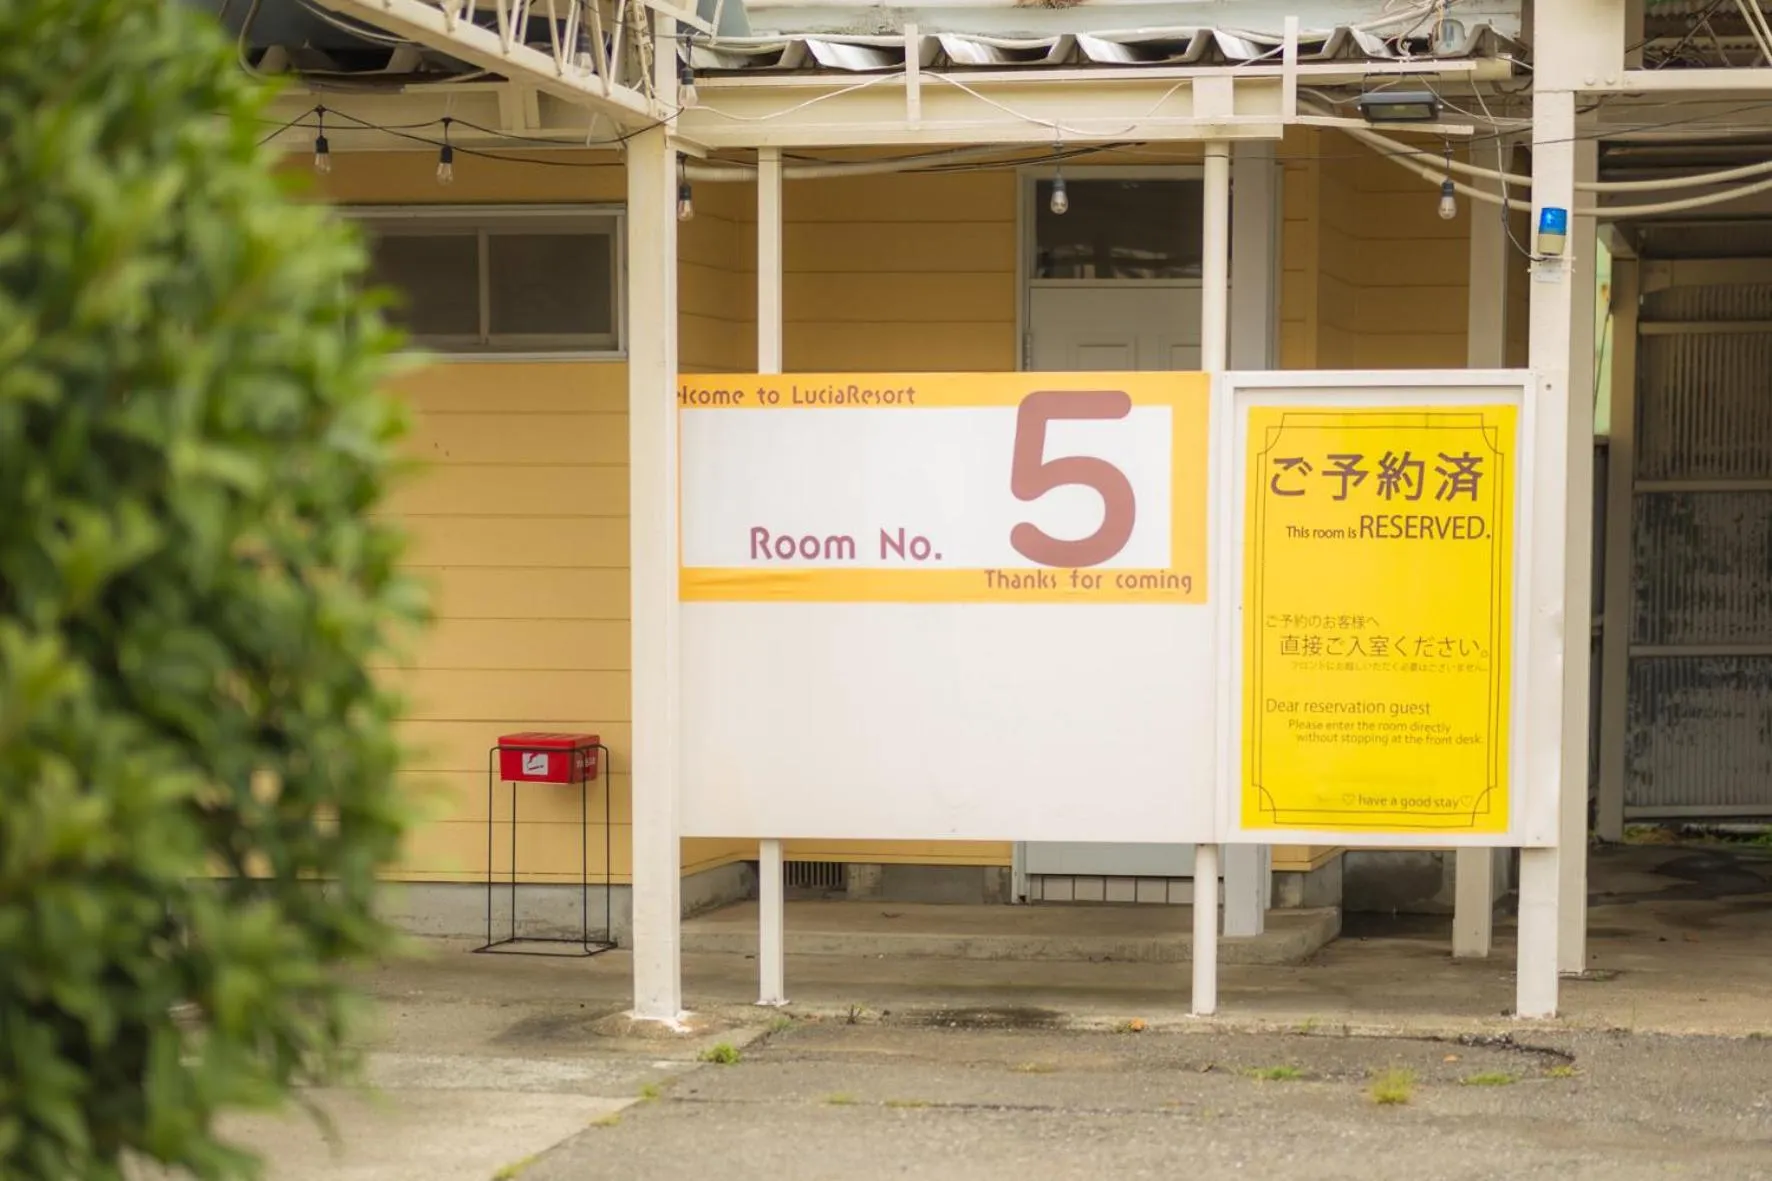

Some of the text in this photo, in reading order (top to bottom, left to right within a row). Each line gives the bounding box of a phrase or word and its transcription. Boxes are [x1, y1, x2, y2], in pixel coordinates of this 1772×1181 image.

[756, 387, 780, 405] to
[792, 385, 915, 405] LuciaResort
[750, 390, 1136, 568] Room No. 5
[1270, 450, 1484, 502] ご予約済
[1286, 514, 1492, 540] This room is RESERVED.
[984, 568, 1193, 595] Thanks for coming
[1265, 614, 1380, 630] ご予約のお客様へ
[1280, 634, 1489, 659] 直接ご入室ください。
[1265, 698, 1431, 717] Dear reservation guest
[1288, 718, 1452, 735] Please enter the room directly
[1296, 731, 1339, 743] without
[1340, 732, 1389, 746] stopping
[1391, 734, 1402, 744] at
[1404, 733, 1424, 745] the
[1425, 733, 1453, 746] front
[1358, 793, 1460, 810] have a good stay
